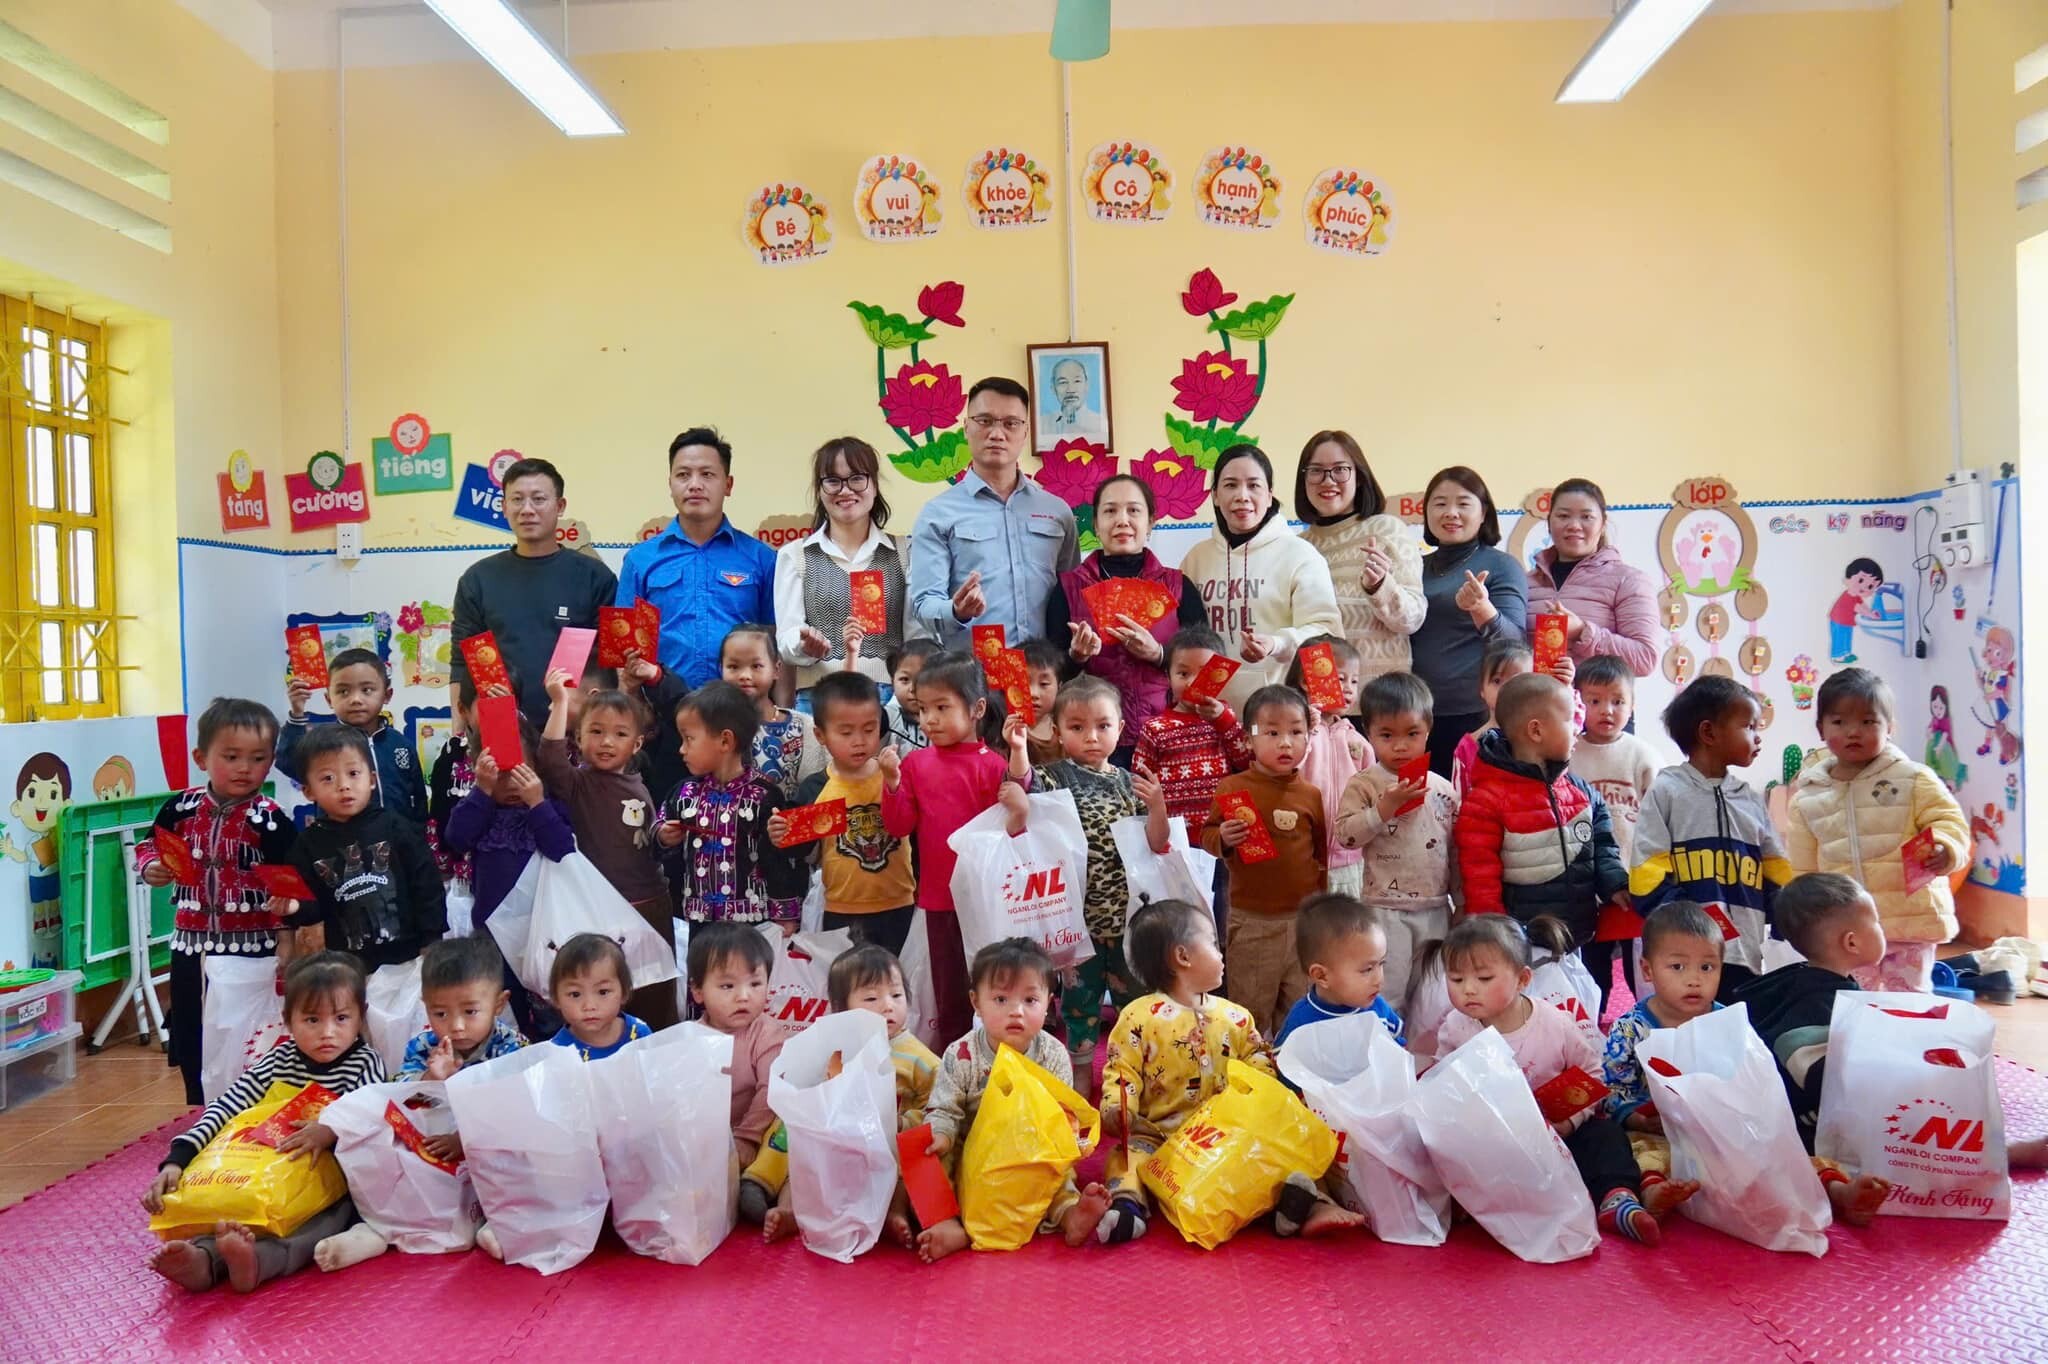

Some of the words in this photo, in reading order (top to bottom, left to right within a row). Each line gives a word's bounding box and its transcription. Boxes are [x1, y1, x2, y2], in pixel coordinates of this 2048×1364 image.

[775, 218, 796, 236] Bé
[885, 193, 910, 210] vui
[986, 183, 1027, 202] khỏe
[1113, 179, 1138, 197] Cô
[1216, 179, 1258, 200] hạnh
[1325, 204, 1367, 227] phúc
[227, 493, 263, 521] tăng
[292, 485, 364, 514] cường
[380, 449, 447, 479] tiếng
[471, 487, 504, 519] việ
[1690, 481, 1727, 504] lớp
[1022, 867, 1066, 902] NL
[1932, 1152, 1981, 1166] COMPAN
